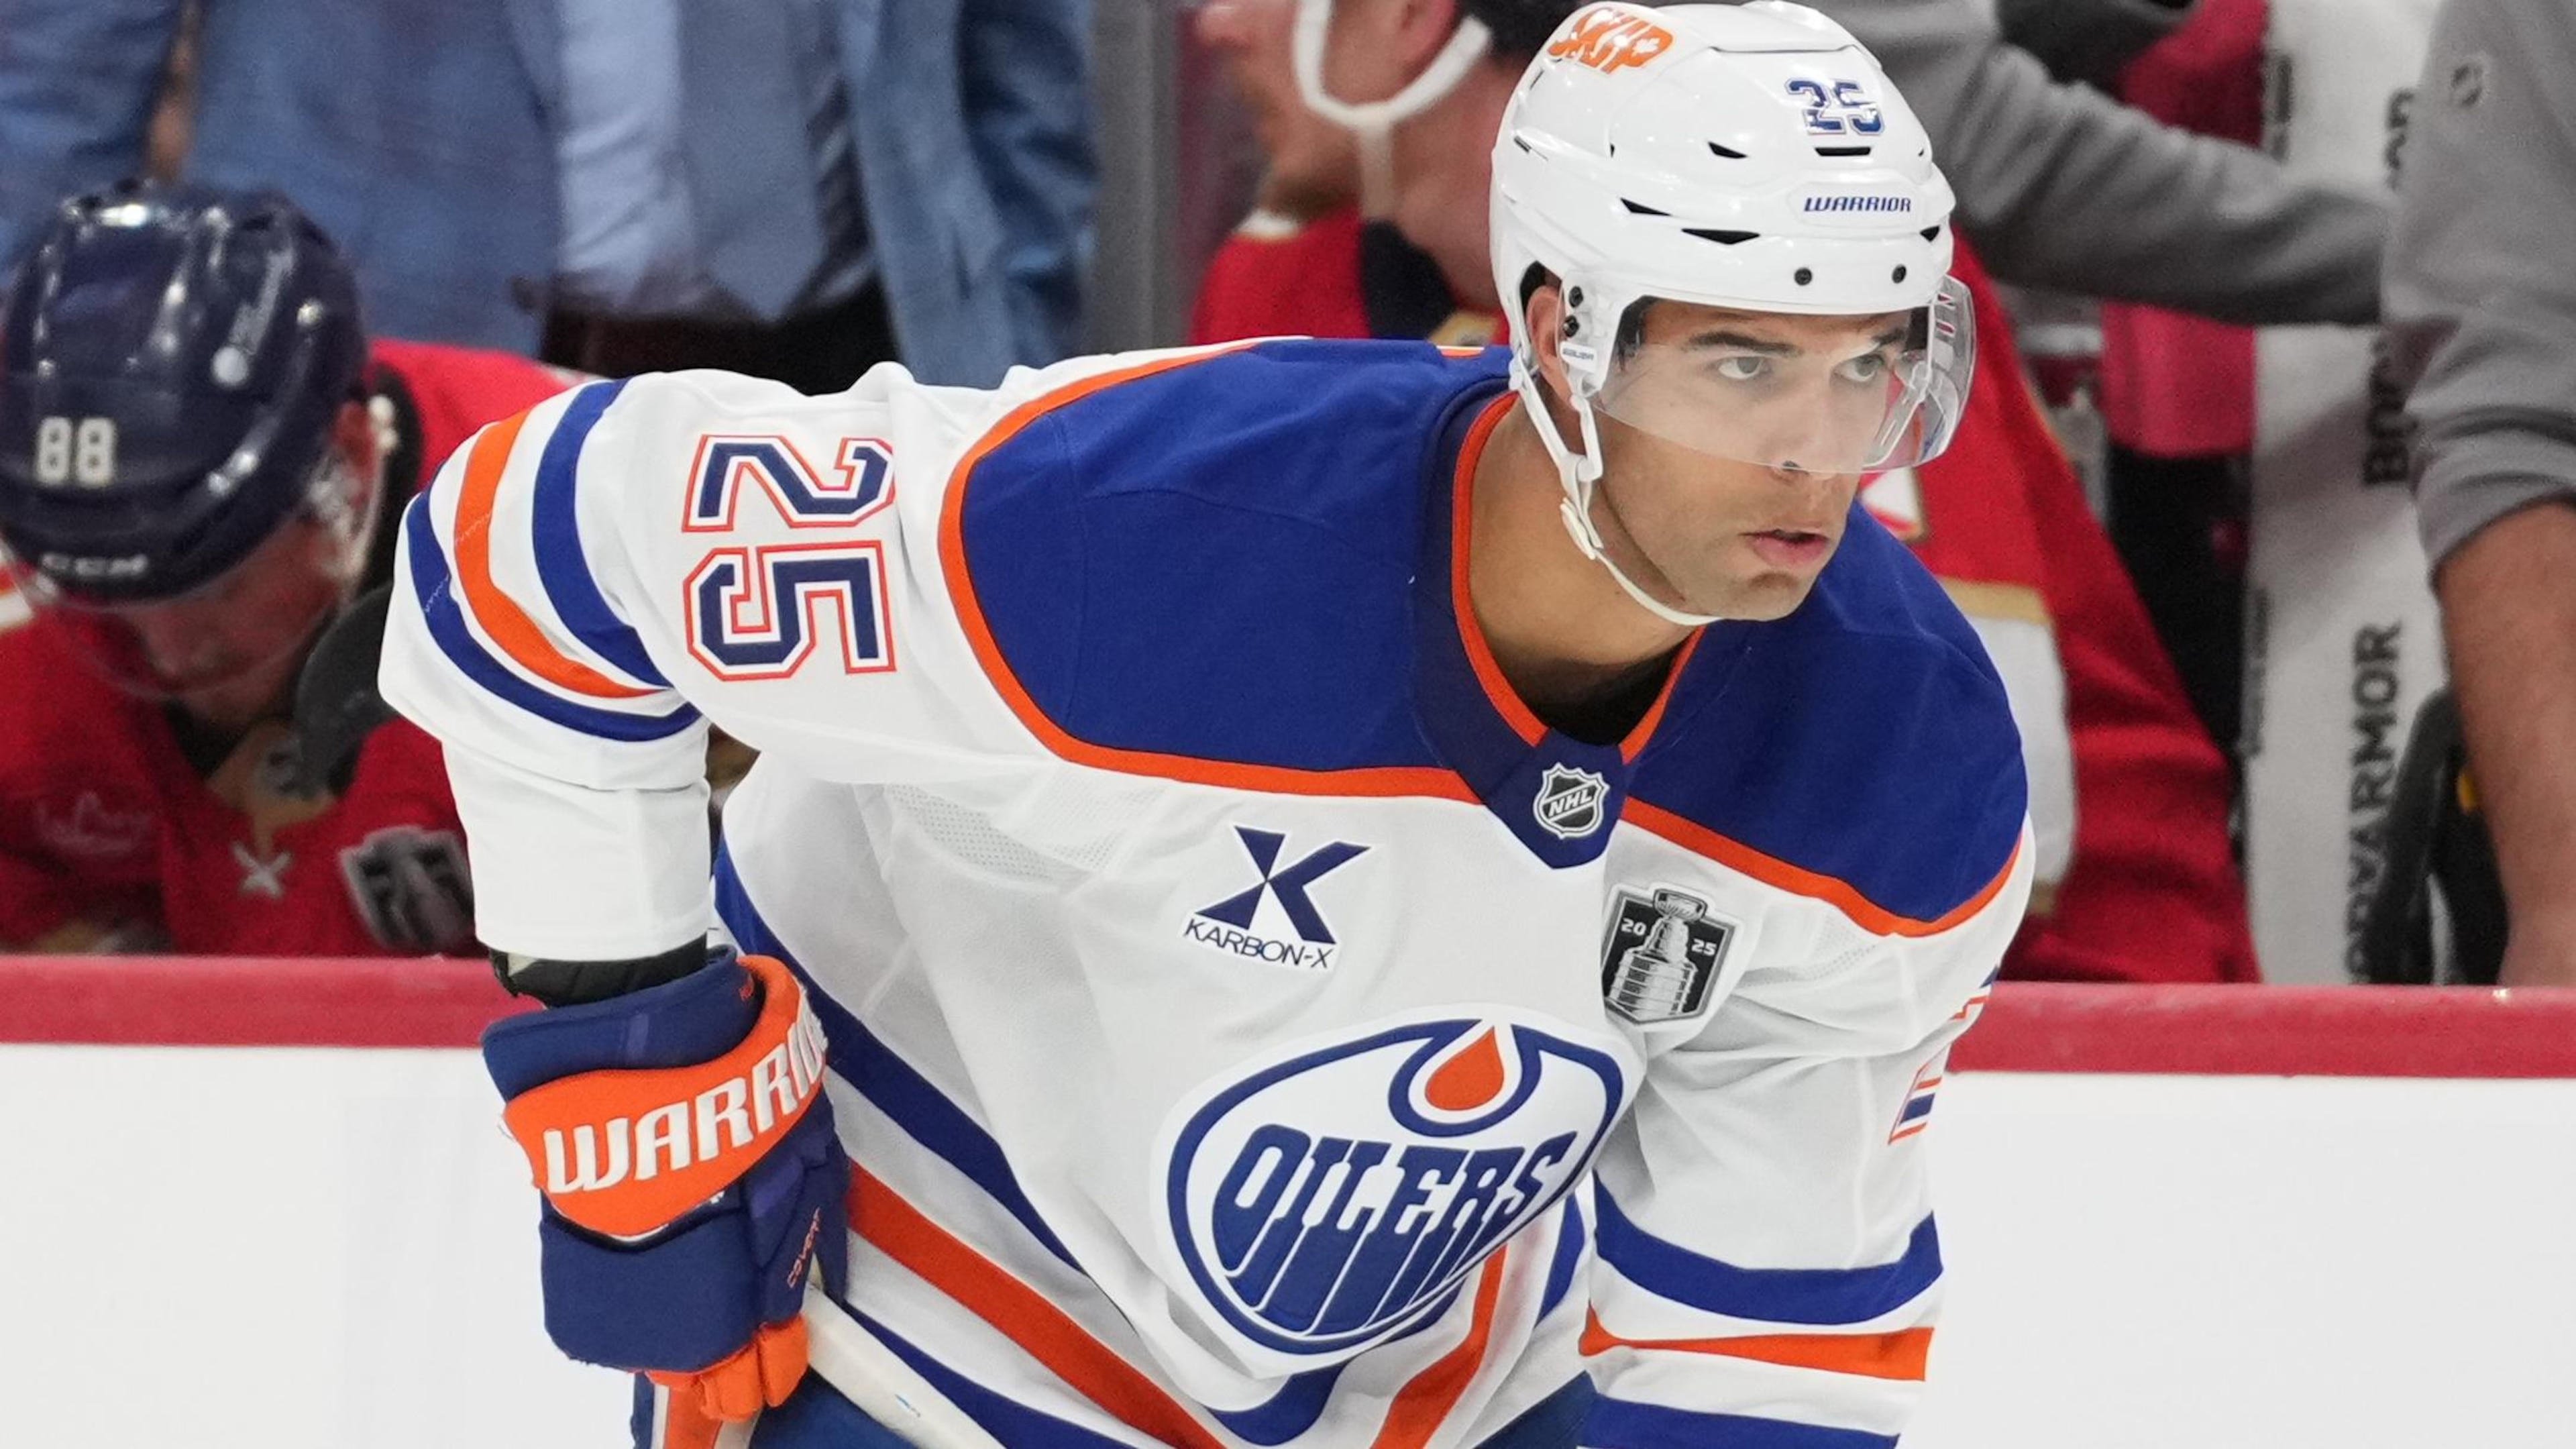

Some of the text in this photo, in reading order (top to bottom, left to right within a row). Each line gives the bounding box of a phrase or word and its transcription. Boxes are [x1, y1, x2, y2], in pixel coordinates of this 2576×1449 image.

[1784, 77, 1885, 136] 25
[1803, 196, 1912, 212] WARRIOR
[37, 416, 115, 489] 88
[682, 434, 897, 682] 25
[1548, 788, 1593, 817] NHL
[1183, 918, 1334, 968] KARBON-X
[1621, 918, 1717, 956] 20 25
[543, 993, 828, 1194] WARRIO
[1212, 1124, 1578, 1336] OILERS
